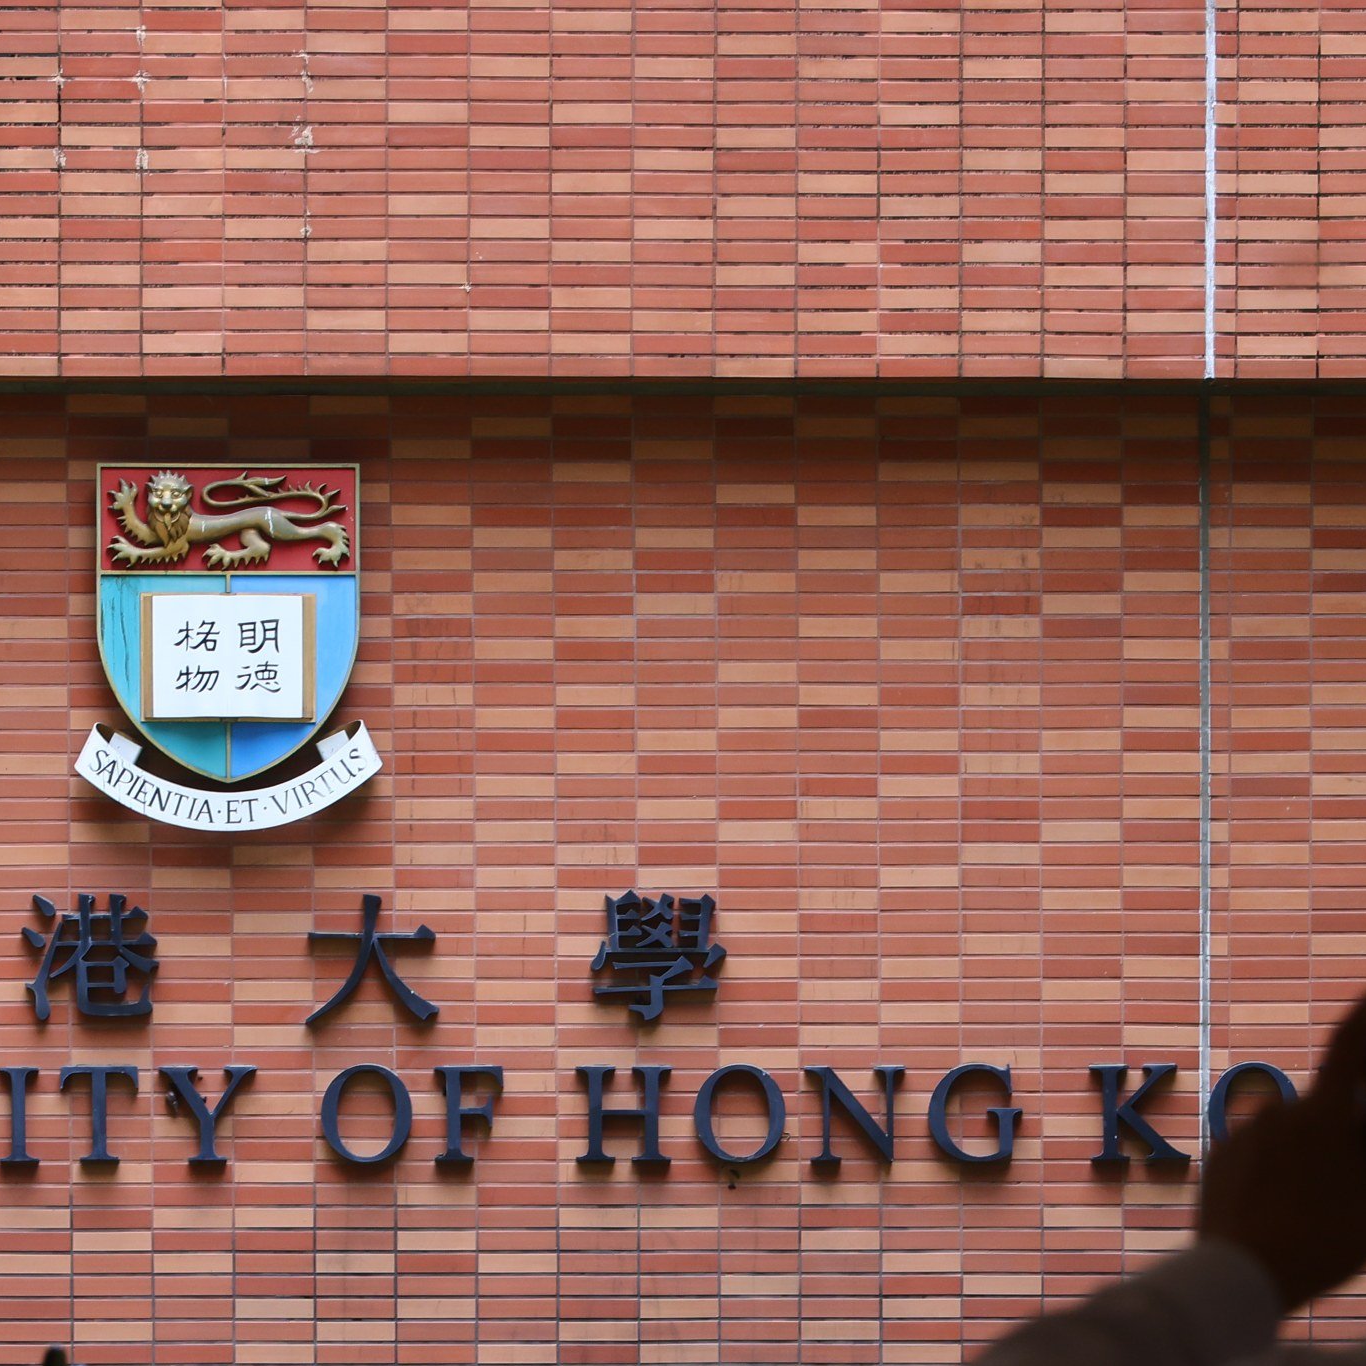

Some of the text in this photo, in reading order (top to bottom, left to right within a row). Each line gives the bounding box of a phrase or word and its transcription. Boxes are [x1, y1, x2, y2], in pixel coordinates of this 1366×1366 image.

[89, 748, 367, 825] SAPIENTIA ET VIRTUS
[320, 1063, 504, 1163] OF
[576, 1062, 1023, 1163] HONG
